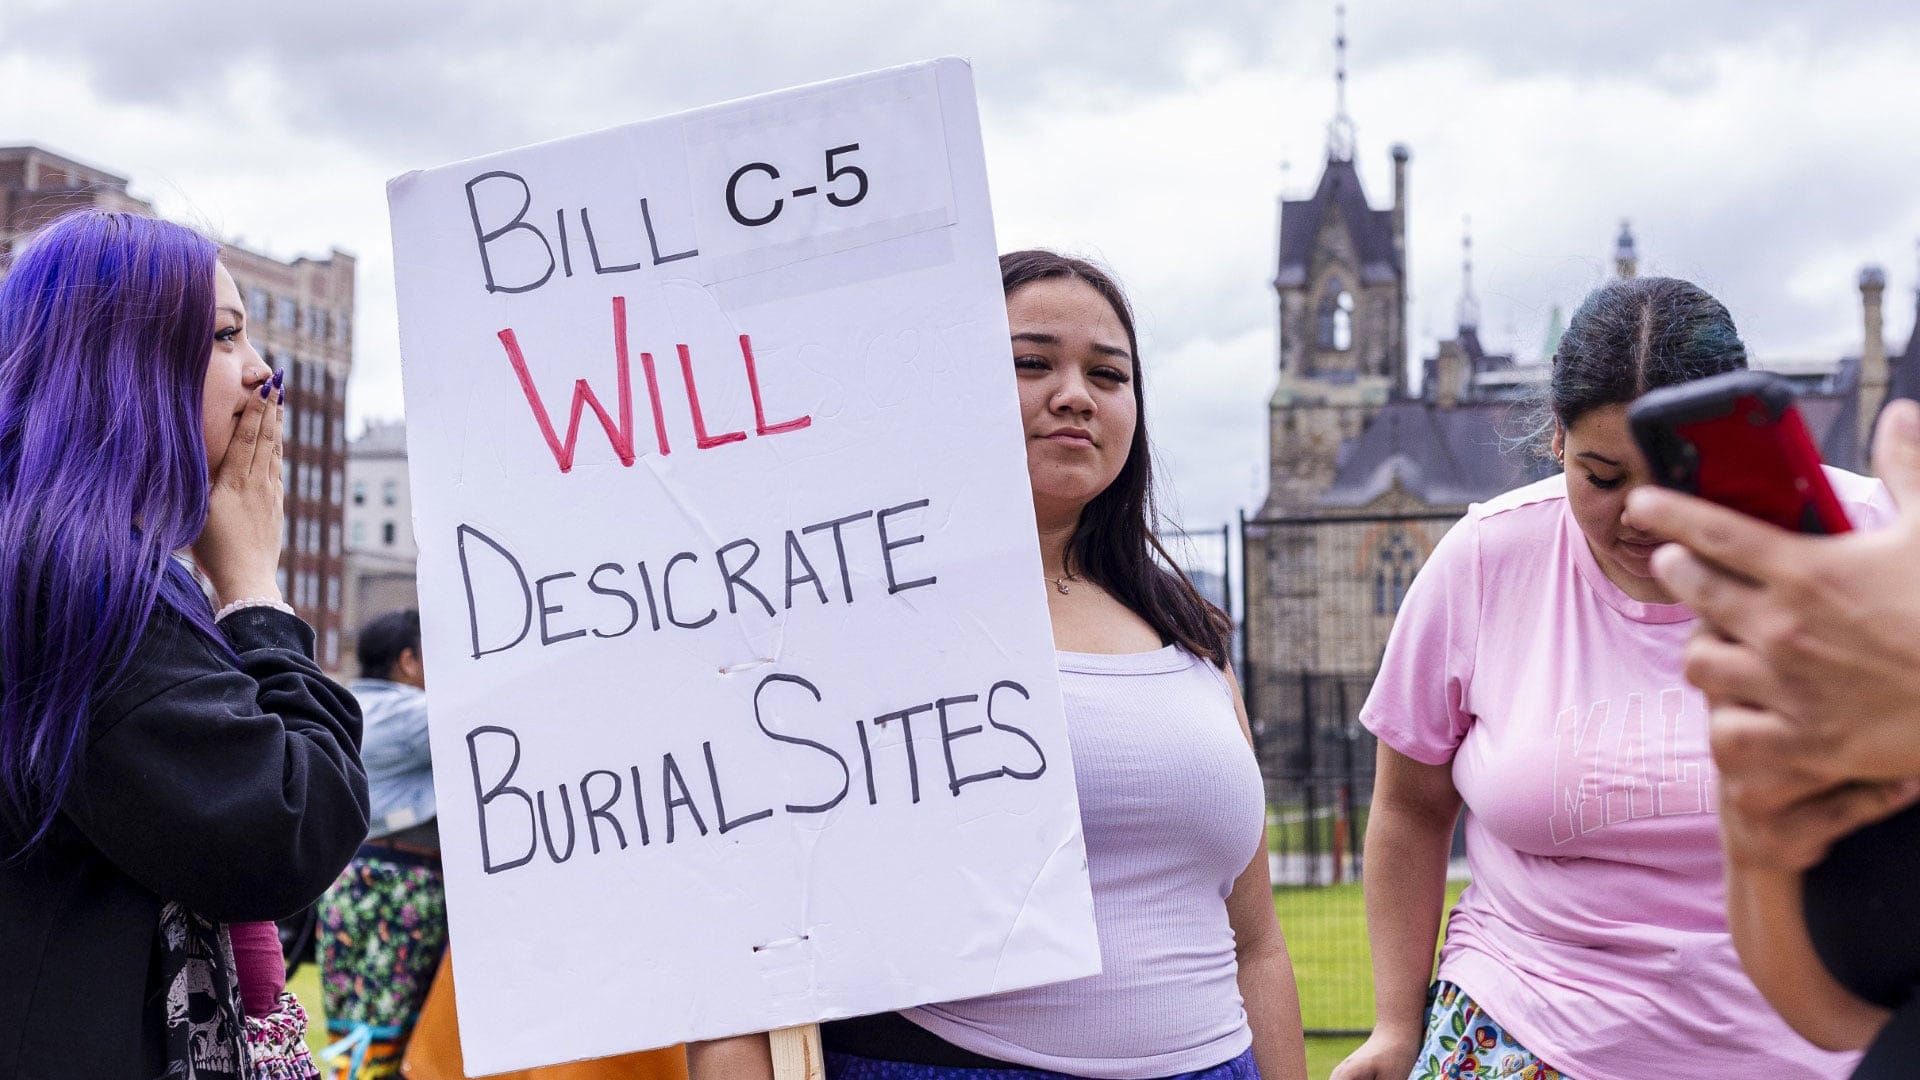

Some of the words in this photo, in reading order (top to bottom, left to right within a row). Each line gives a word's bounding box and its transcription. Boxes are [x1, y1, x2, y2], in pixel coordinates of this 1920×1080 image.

[463, 170, 699, 295] BILL
[724, 142, 869, 227] C-5
[496, 295, 812, 474] WILL
[456, 498, 938, 661] DESICRATE
[465, 725, 774, 875] BURIAL
[753, 672, 1047, 814] SITES
[1549, 687, 1720, 846] MAL
